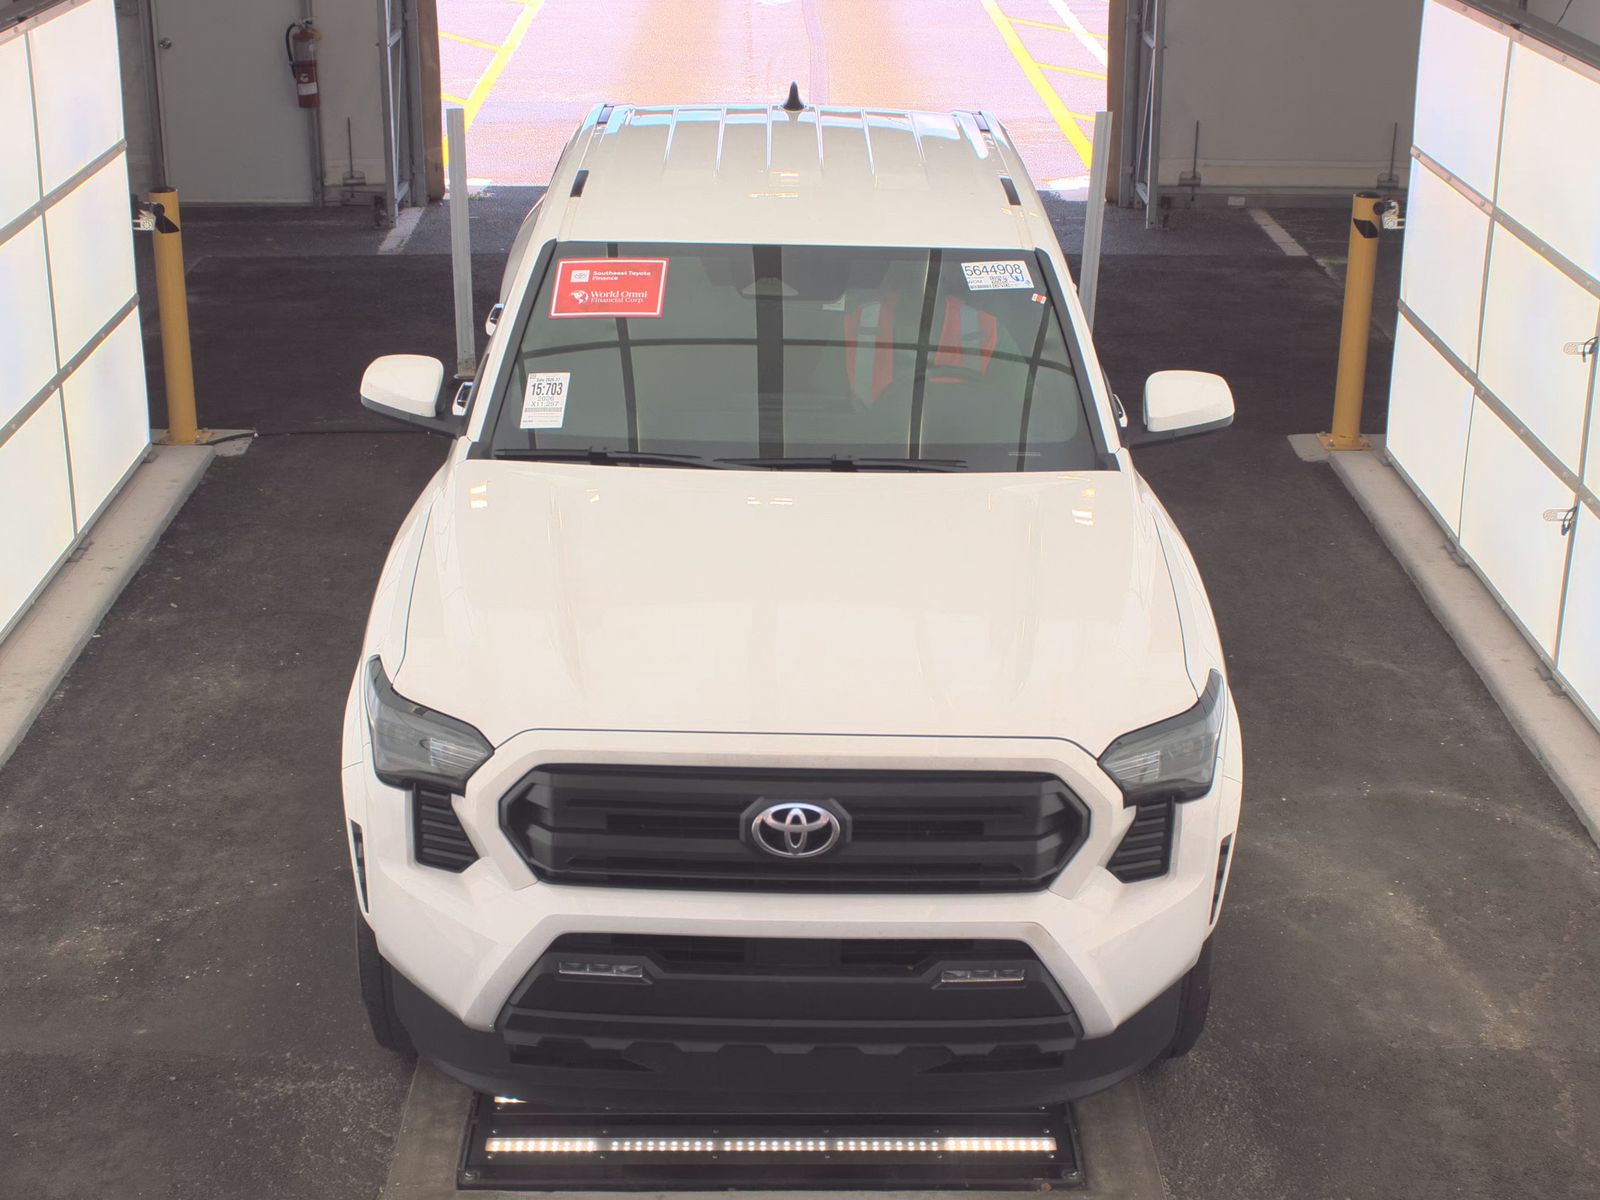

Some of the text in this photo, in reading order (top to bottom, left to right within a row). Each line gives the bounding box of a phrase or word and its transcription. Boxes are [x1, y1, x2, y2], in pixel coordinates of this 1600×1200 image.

[964, 264, 1022, 276] 5644908
[591, 290, 648, 298] World Omni
[531, 382, 563, 396] 15:703
